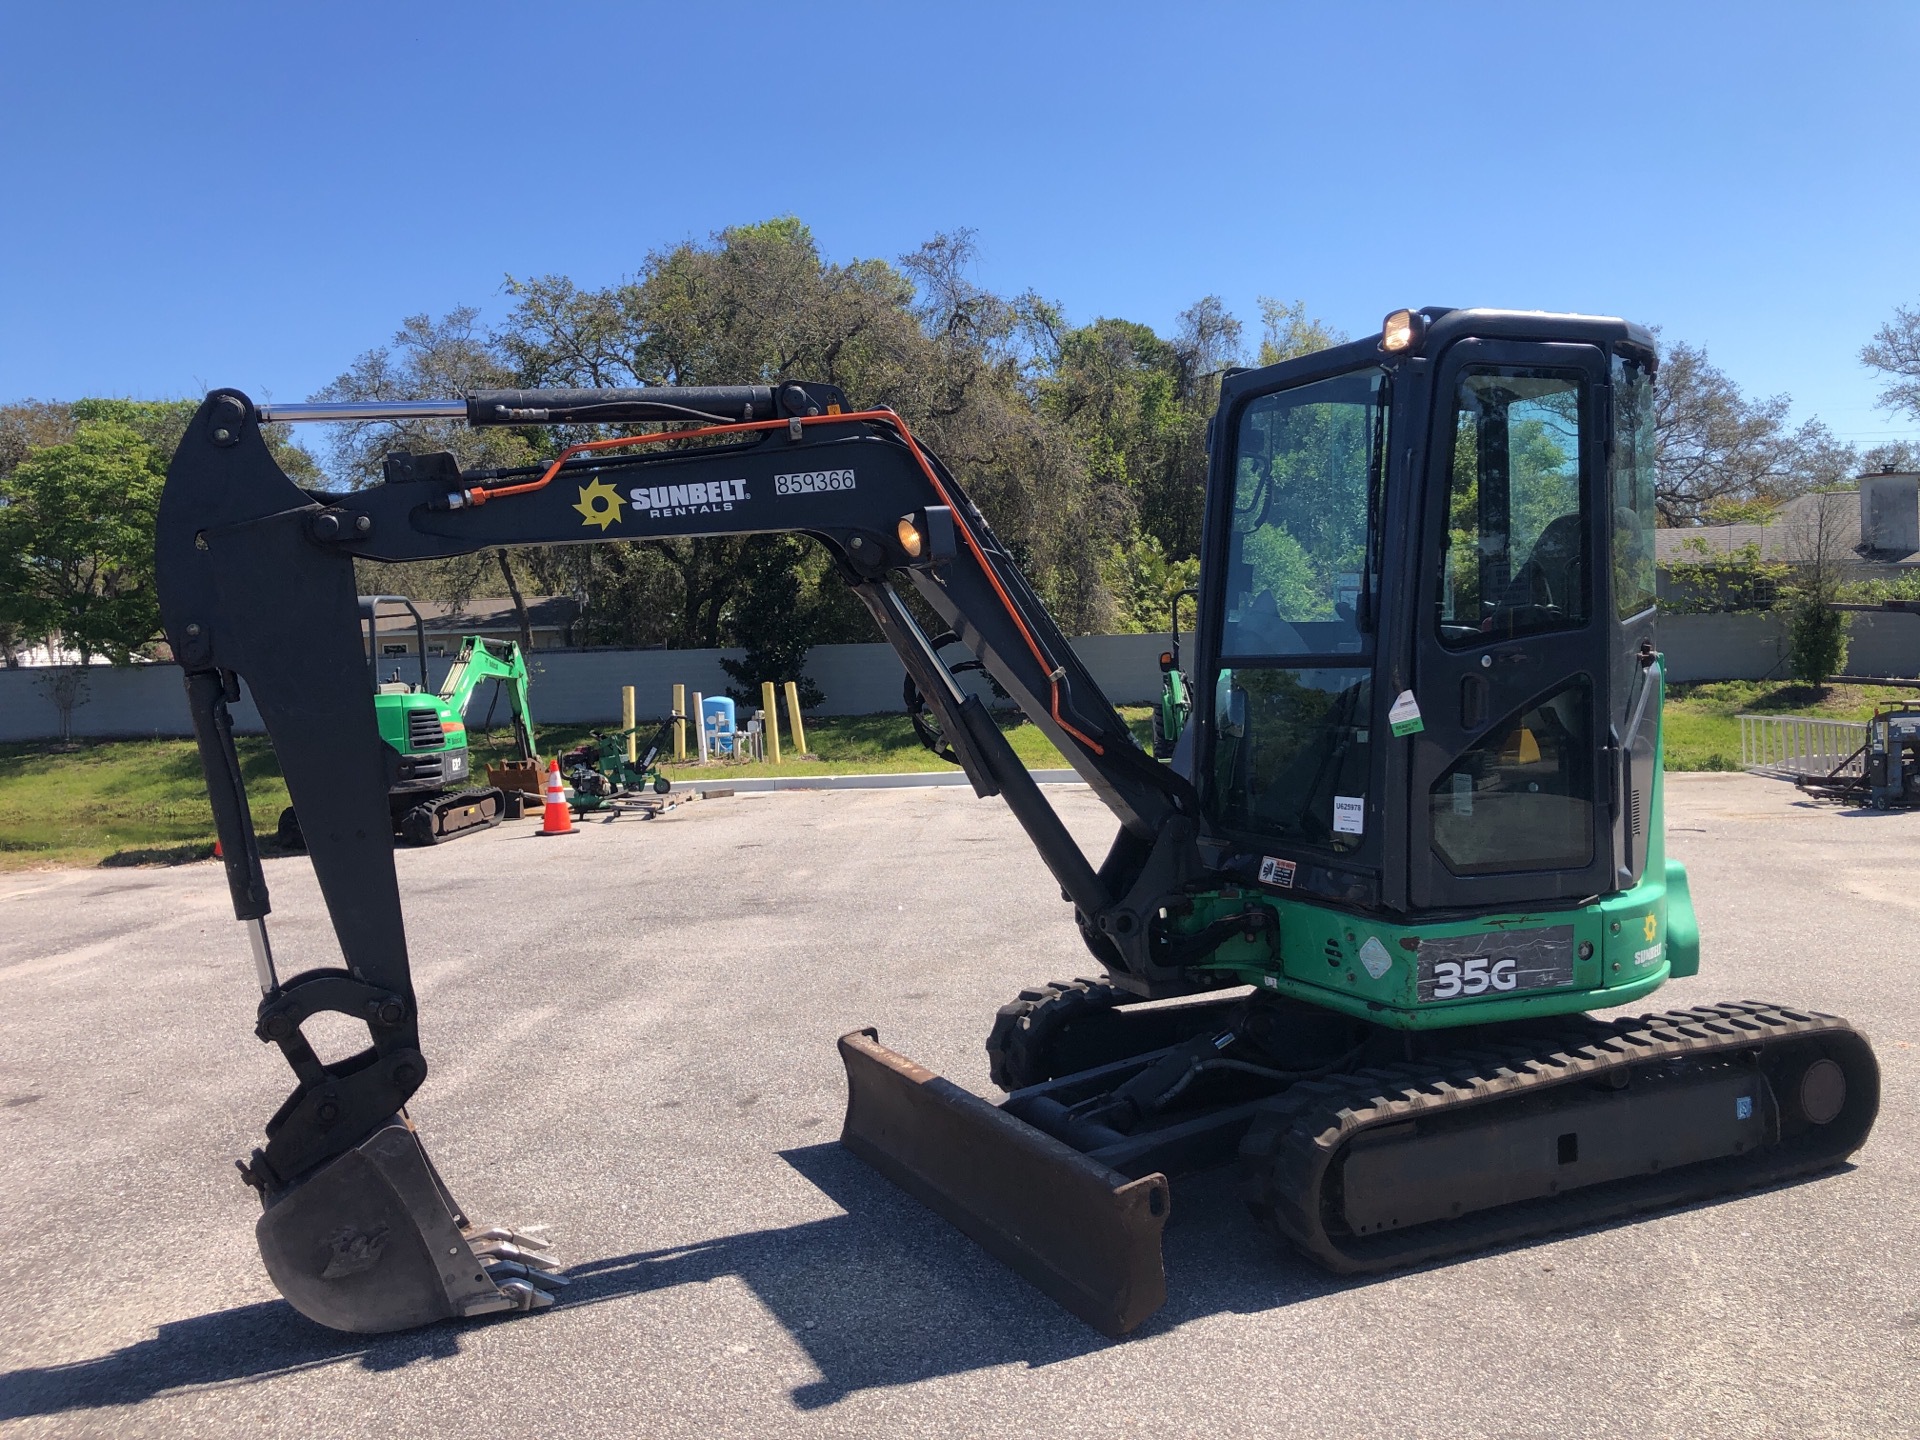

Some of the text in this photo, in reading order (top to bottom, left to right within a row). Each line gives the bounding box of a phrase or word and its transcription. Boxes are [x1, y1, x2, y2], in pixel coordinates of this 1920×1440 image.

[630, 479, 747, 510] SUNBELT
[776, 470, 854, 494] 859366
[650, 502, 733, 518] RENTALS
[1434, 958, 1517, 997] 35G
